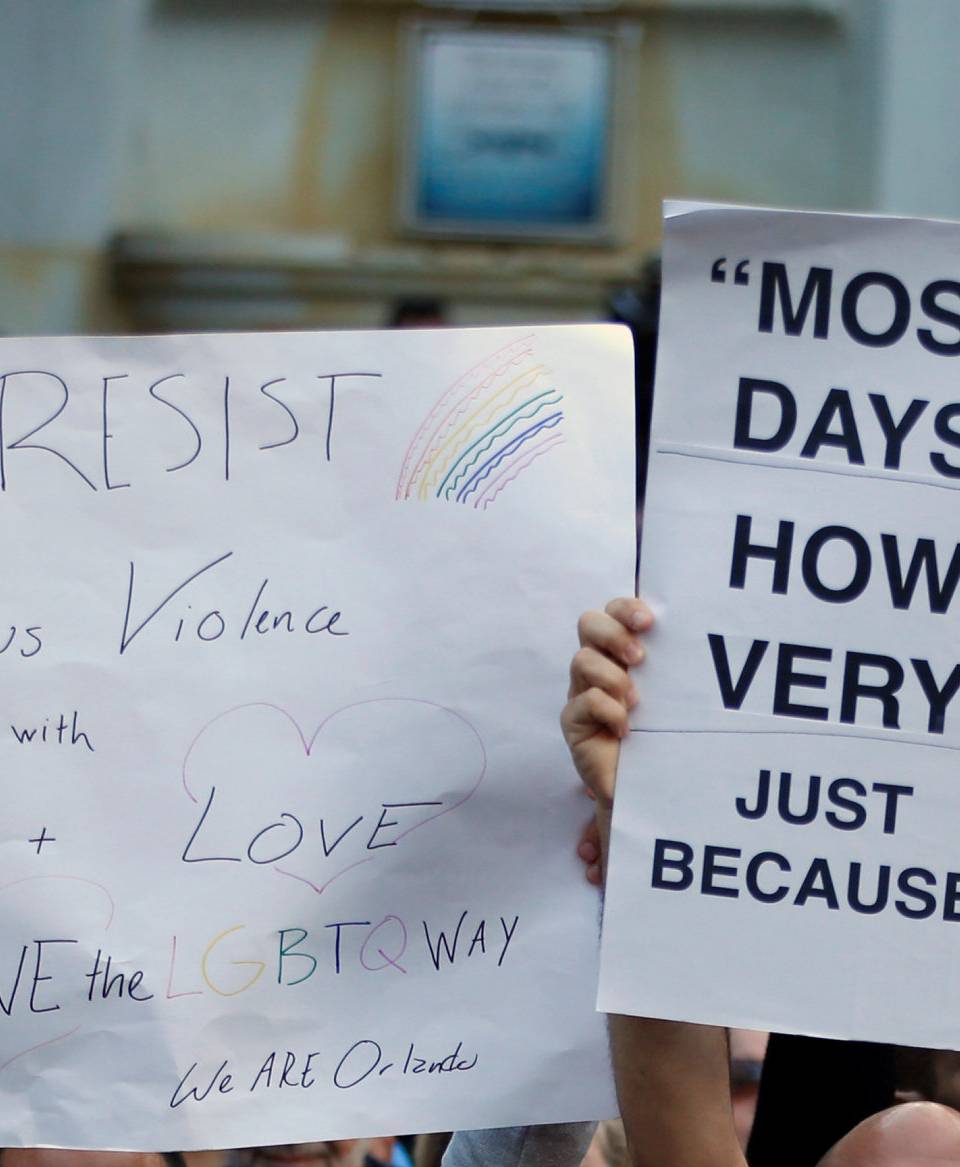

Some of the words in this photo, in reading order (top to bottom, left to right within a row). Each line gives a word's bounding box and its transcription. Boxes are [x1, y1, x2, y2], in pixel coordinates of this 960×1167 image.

[0, 370, 383, 491] RESIST
[120, 552, 350, 656] Violence
[11, 711, 95, 755] with
[182, 786, 443, 865] LOVE
[735, 769, 915, 835] JUST
[86, 949, 154, 1002] the
[166, 915, 408, 999] LGBTQ
[423, 910, 520, 971] WAY
[170, 1060, 233, 1108] We
[250, 1051, 320, 1092] ARE
[334, 1039, 478, 1089] Orlando
